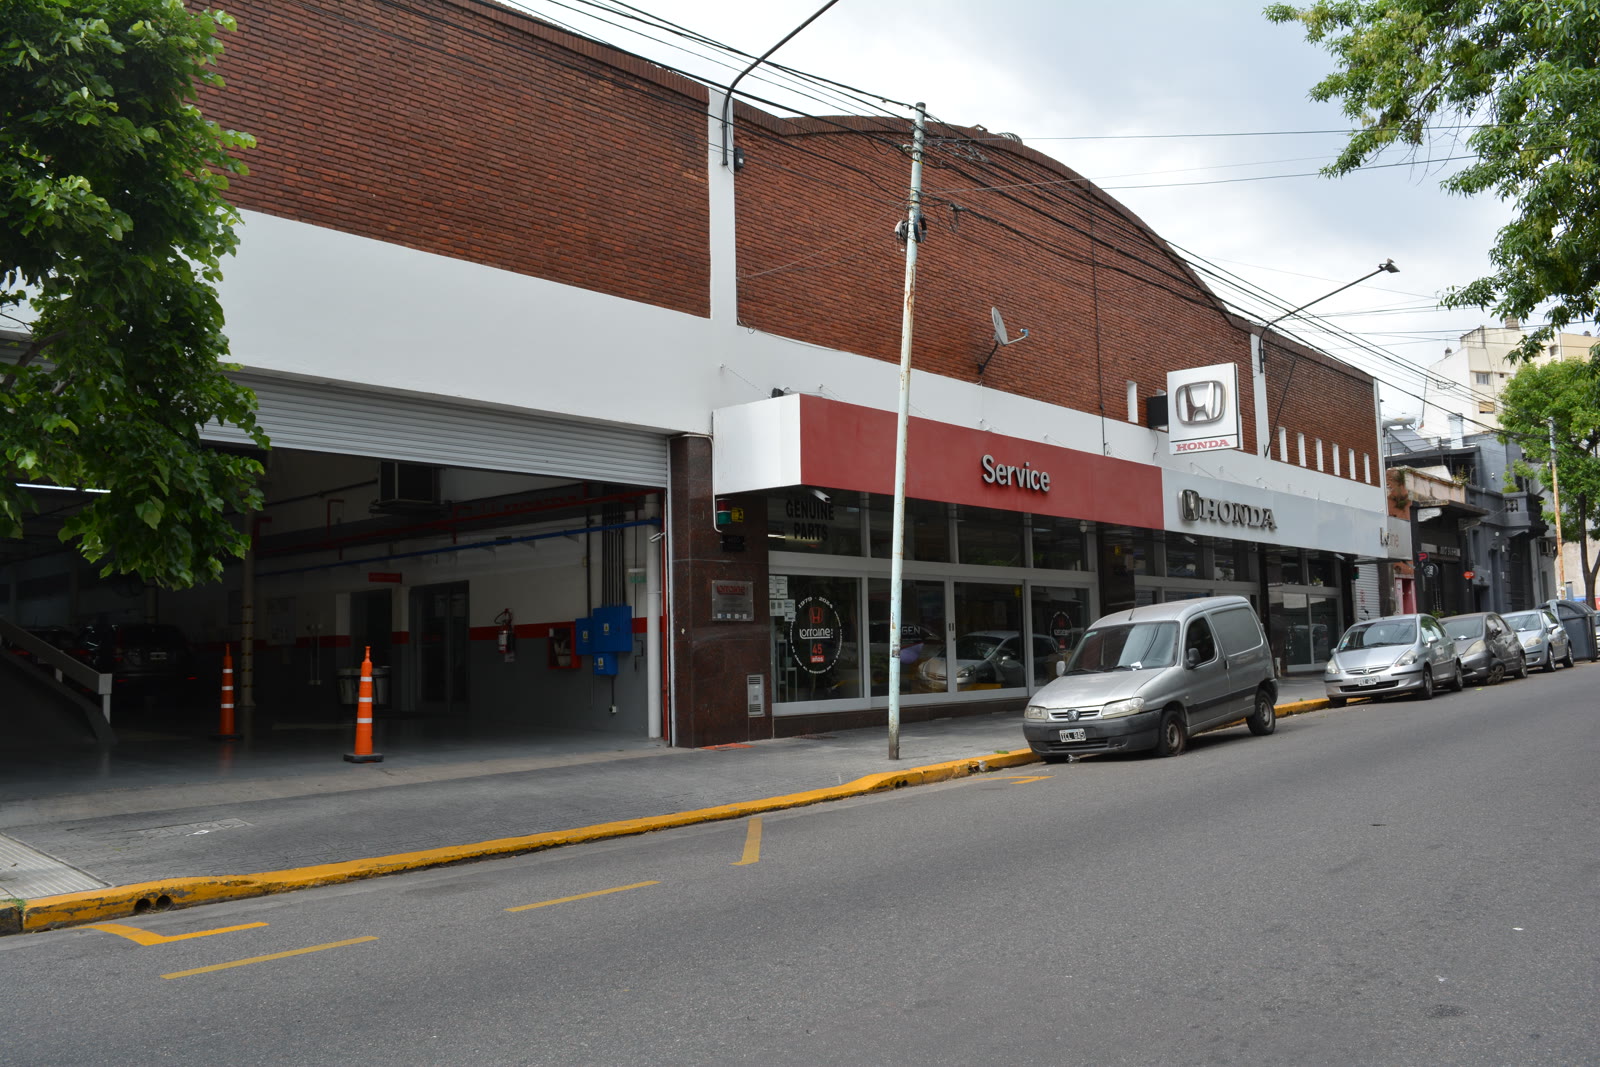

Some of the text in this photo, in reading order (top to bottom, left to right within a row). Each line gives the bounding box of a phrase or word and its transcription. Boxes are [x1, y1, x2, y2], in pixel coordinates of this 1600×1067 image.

[1176, 439, 1230, 452] HONDA
[982, 454, 1051, 493] Service
[786, 499, 835, 521] GENUINE
[1199, 496, 1278, 530] HONDA
[794, 522, 829, 542] PARTS
[798, 596, 833, 609] 1979 2024
[812, 643, 823, 655] 45
